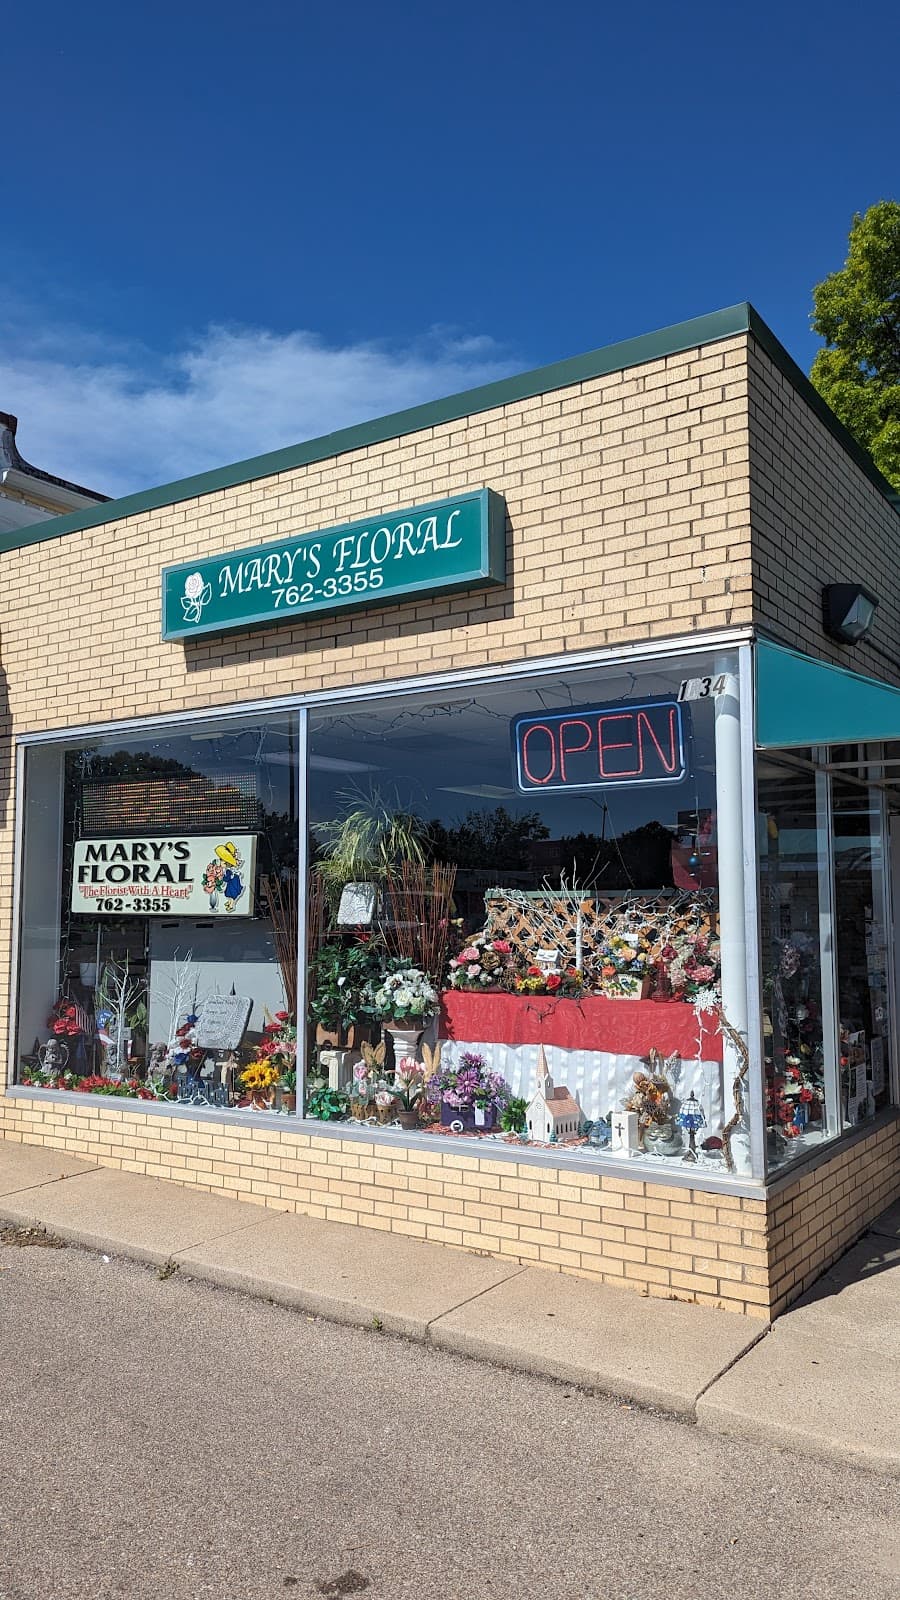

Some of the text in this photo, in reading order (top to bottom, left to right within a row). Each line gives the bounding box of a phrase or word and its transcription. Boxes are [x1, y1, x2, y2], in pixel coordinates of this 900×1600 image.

[219, 510, 462, 597] MARY'S FLORAL
[271, 568, 384, 608] 762-3355
[523, 709, 675, 784] OPEN
[85, 841, 190, 862] MARY'S
[77, 863, 194, 883] FLORAL
[151, 885, 159, 897] A
[95, 898, 171, 912] 762-3355
